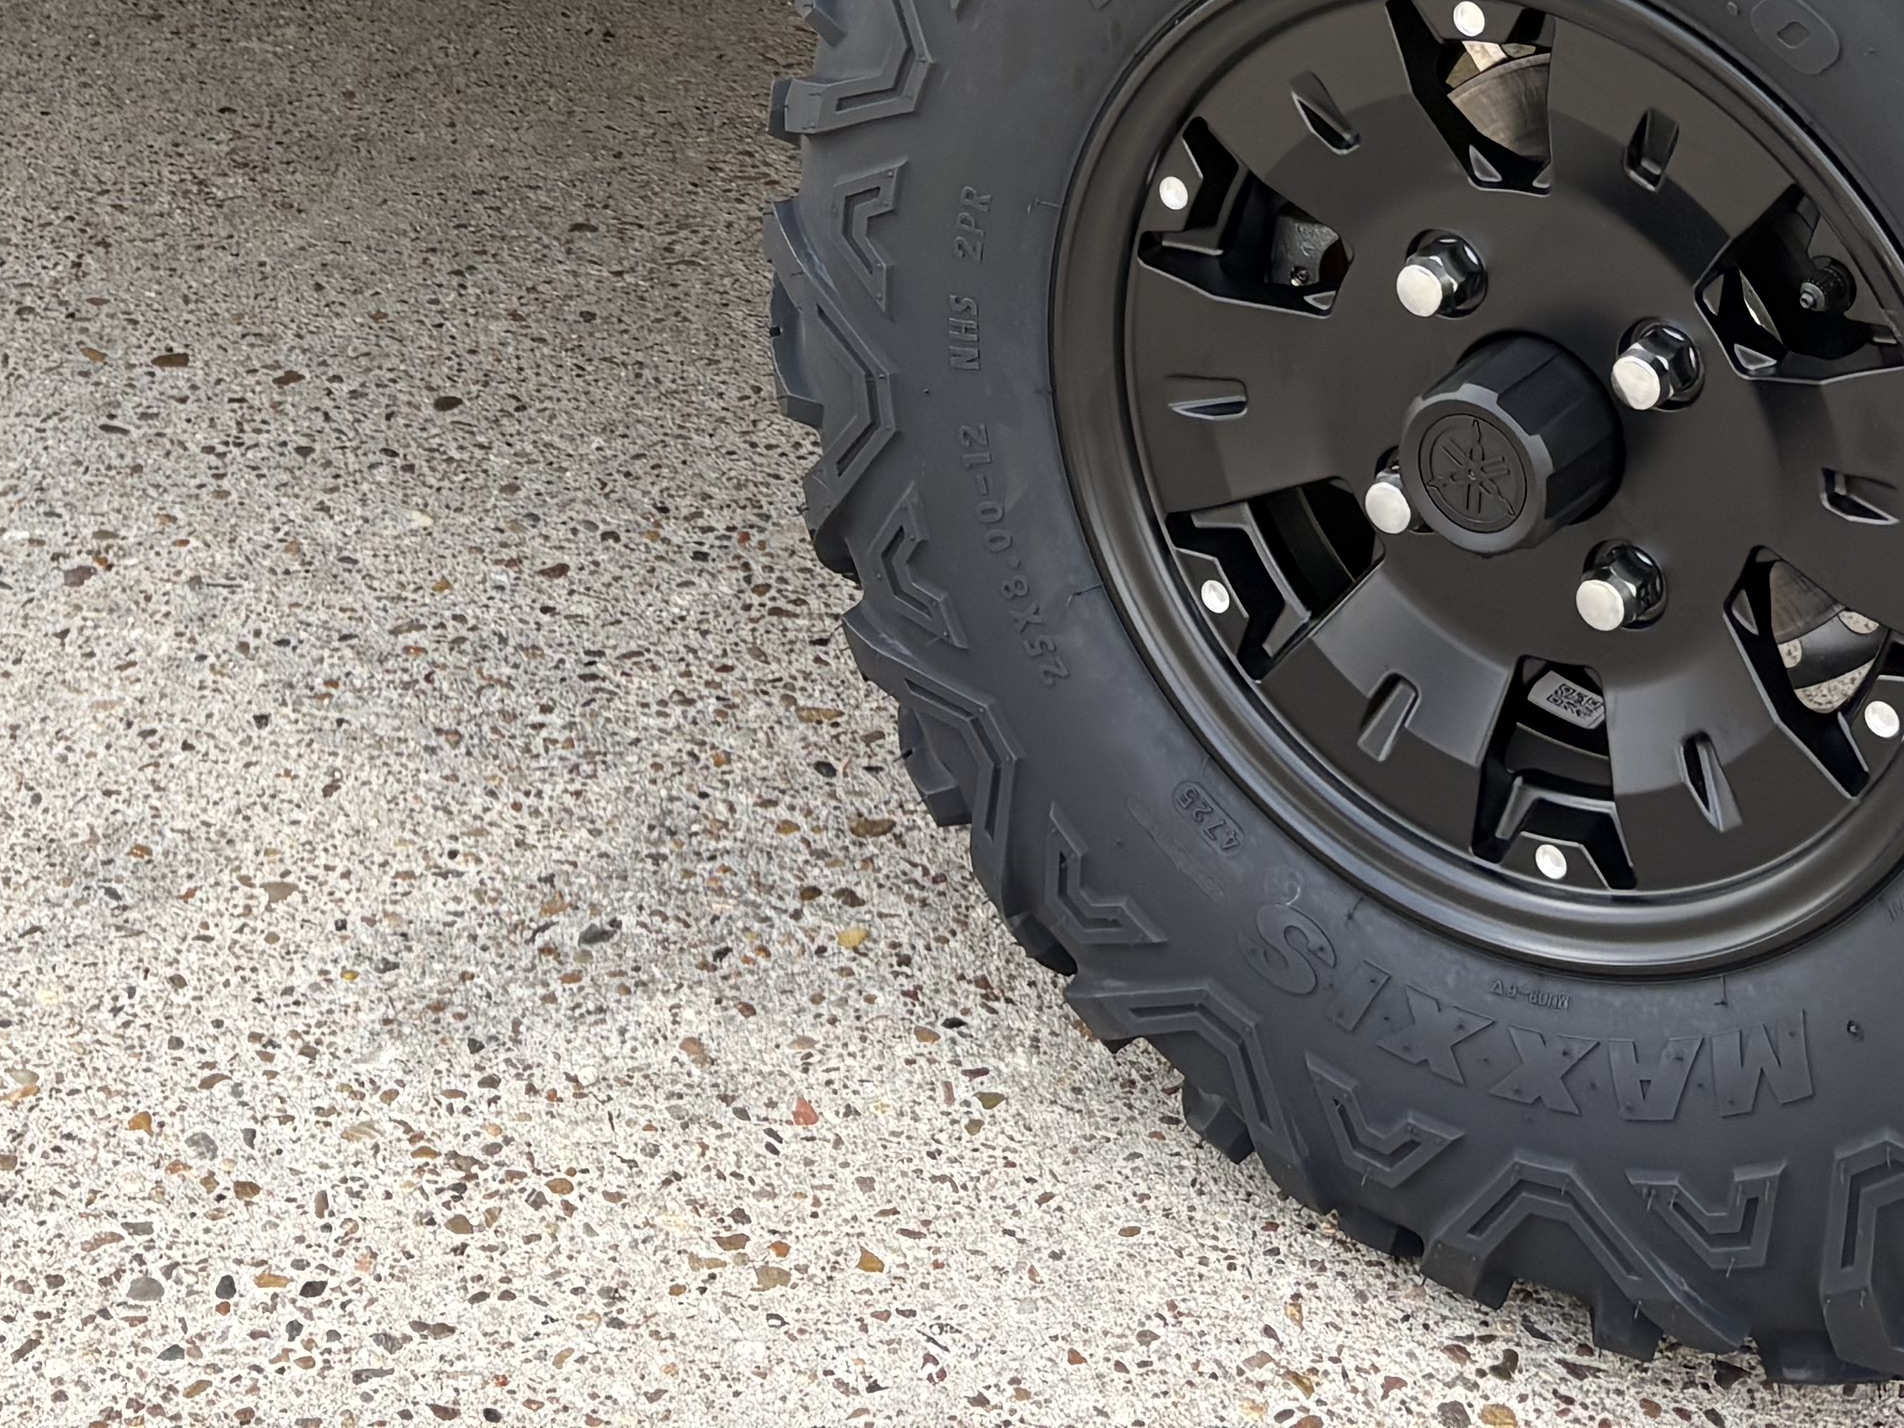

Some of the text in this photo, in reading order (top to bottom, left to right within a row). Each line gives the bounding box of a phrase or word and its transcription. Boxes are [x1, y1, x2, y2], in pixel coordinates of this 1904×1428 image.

[951, 178, 993, 266] 2PR
[947, 290, 981, 373] NHS
[1173, 782, 1244, 859] 4725
[1241, 900, 1817, 1122] MAXXIS
